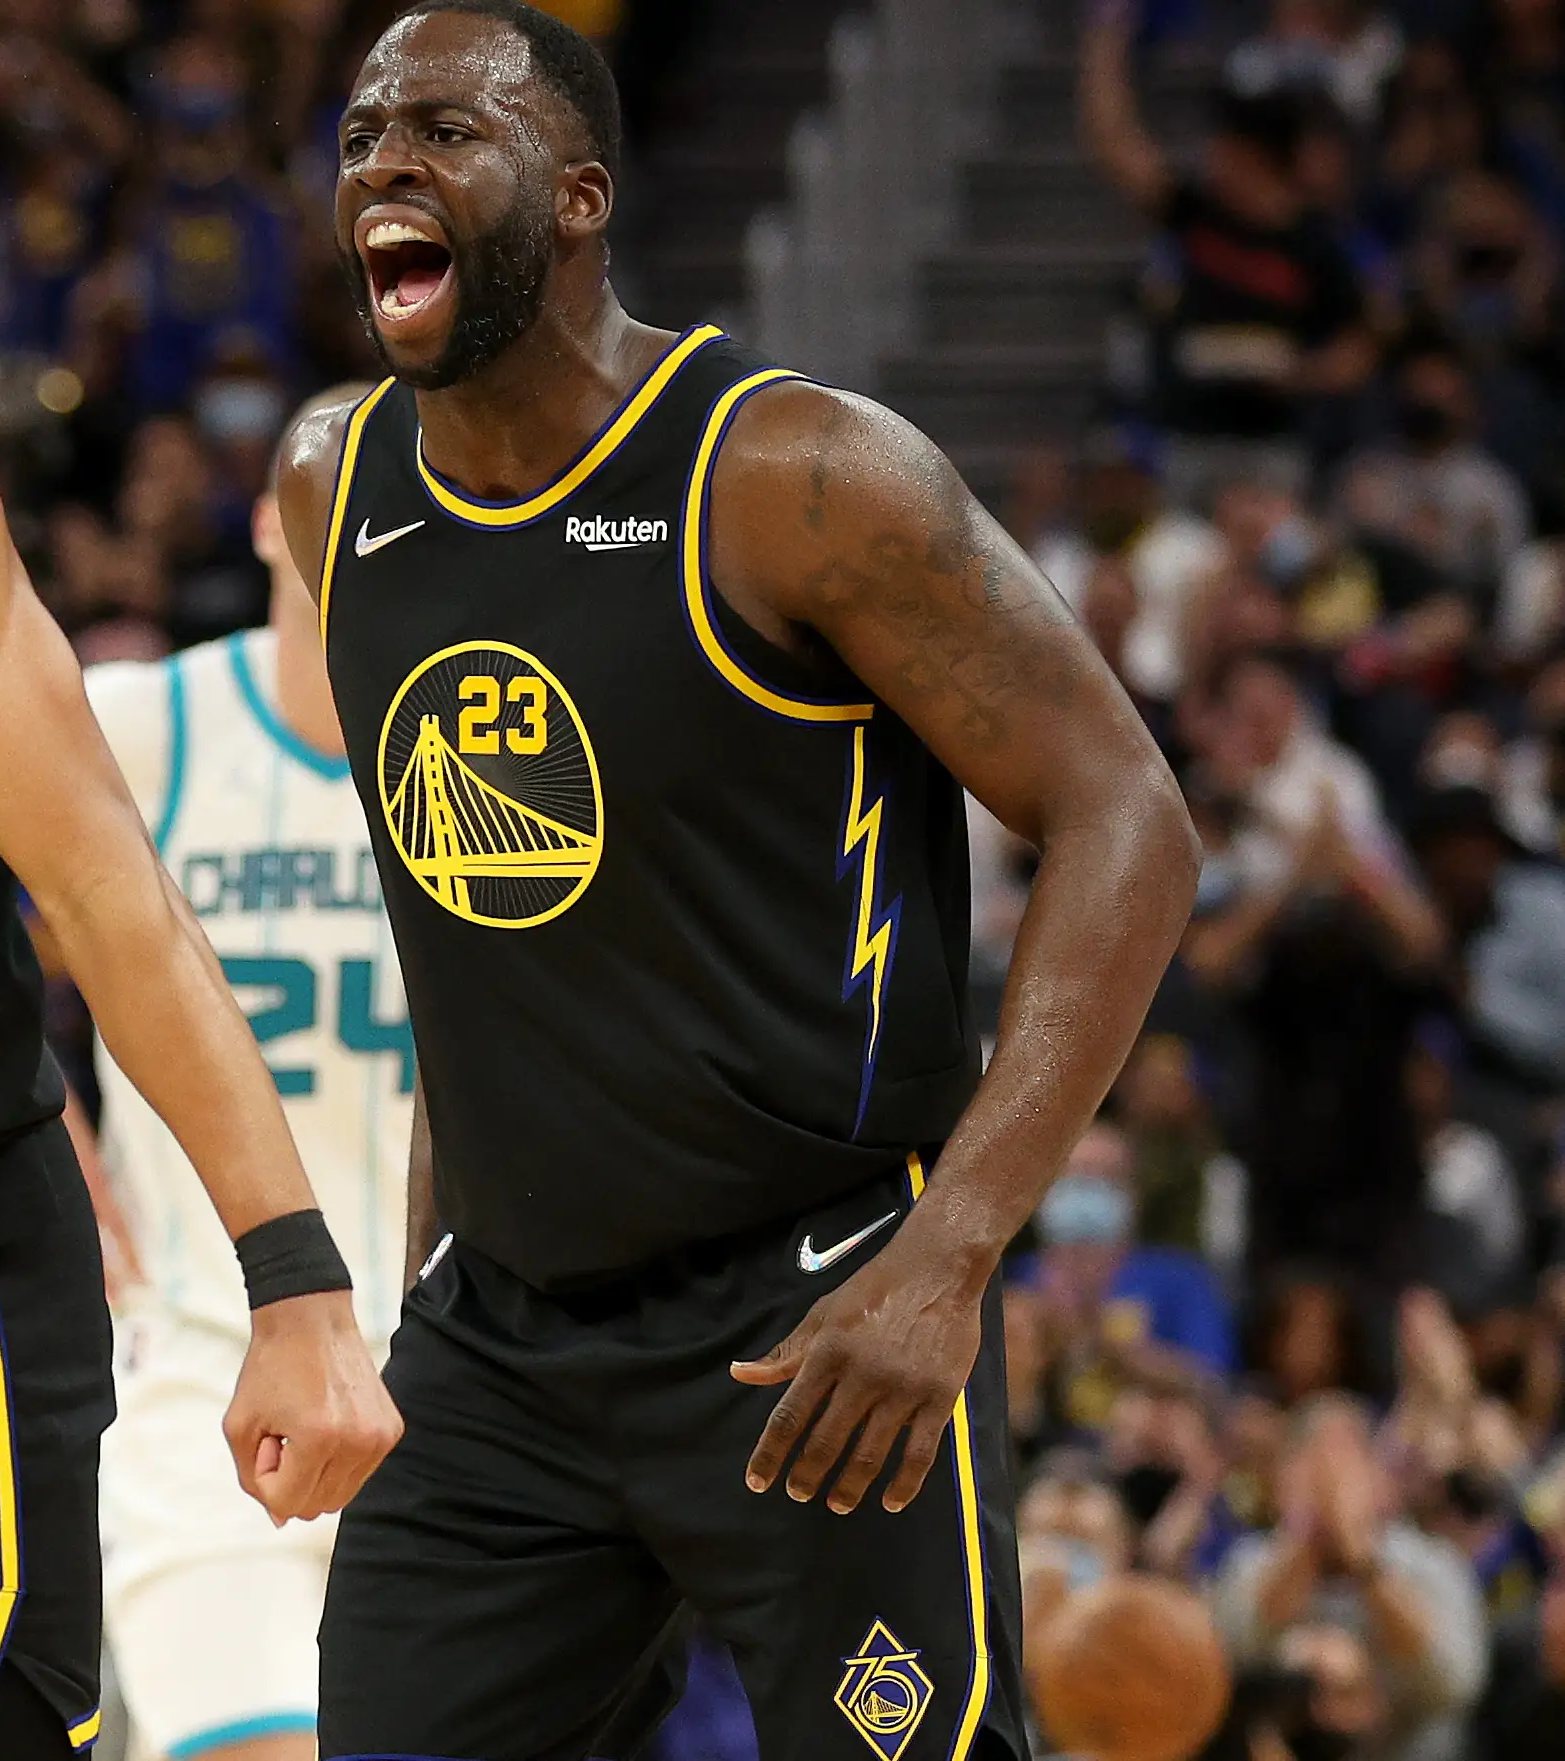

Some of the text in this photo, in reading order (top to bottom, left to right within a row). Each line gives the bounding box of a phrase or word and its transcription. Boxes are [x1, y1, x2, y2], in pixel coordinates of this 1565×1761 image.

[565, 514, 668, 543] Rakuten
[458, 675, 548, 755] 23
[218, 954, 417, 1099] 24
